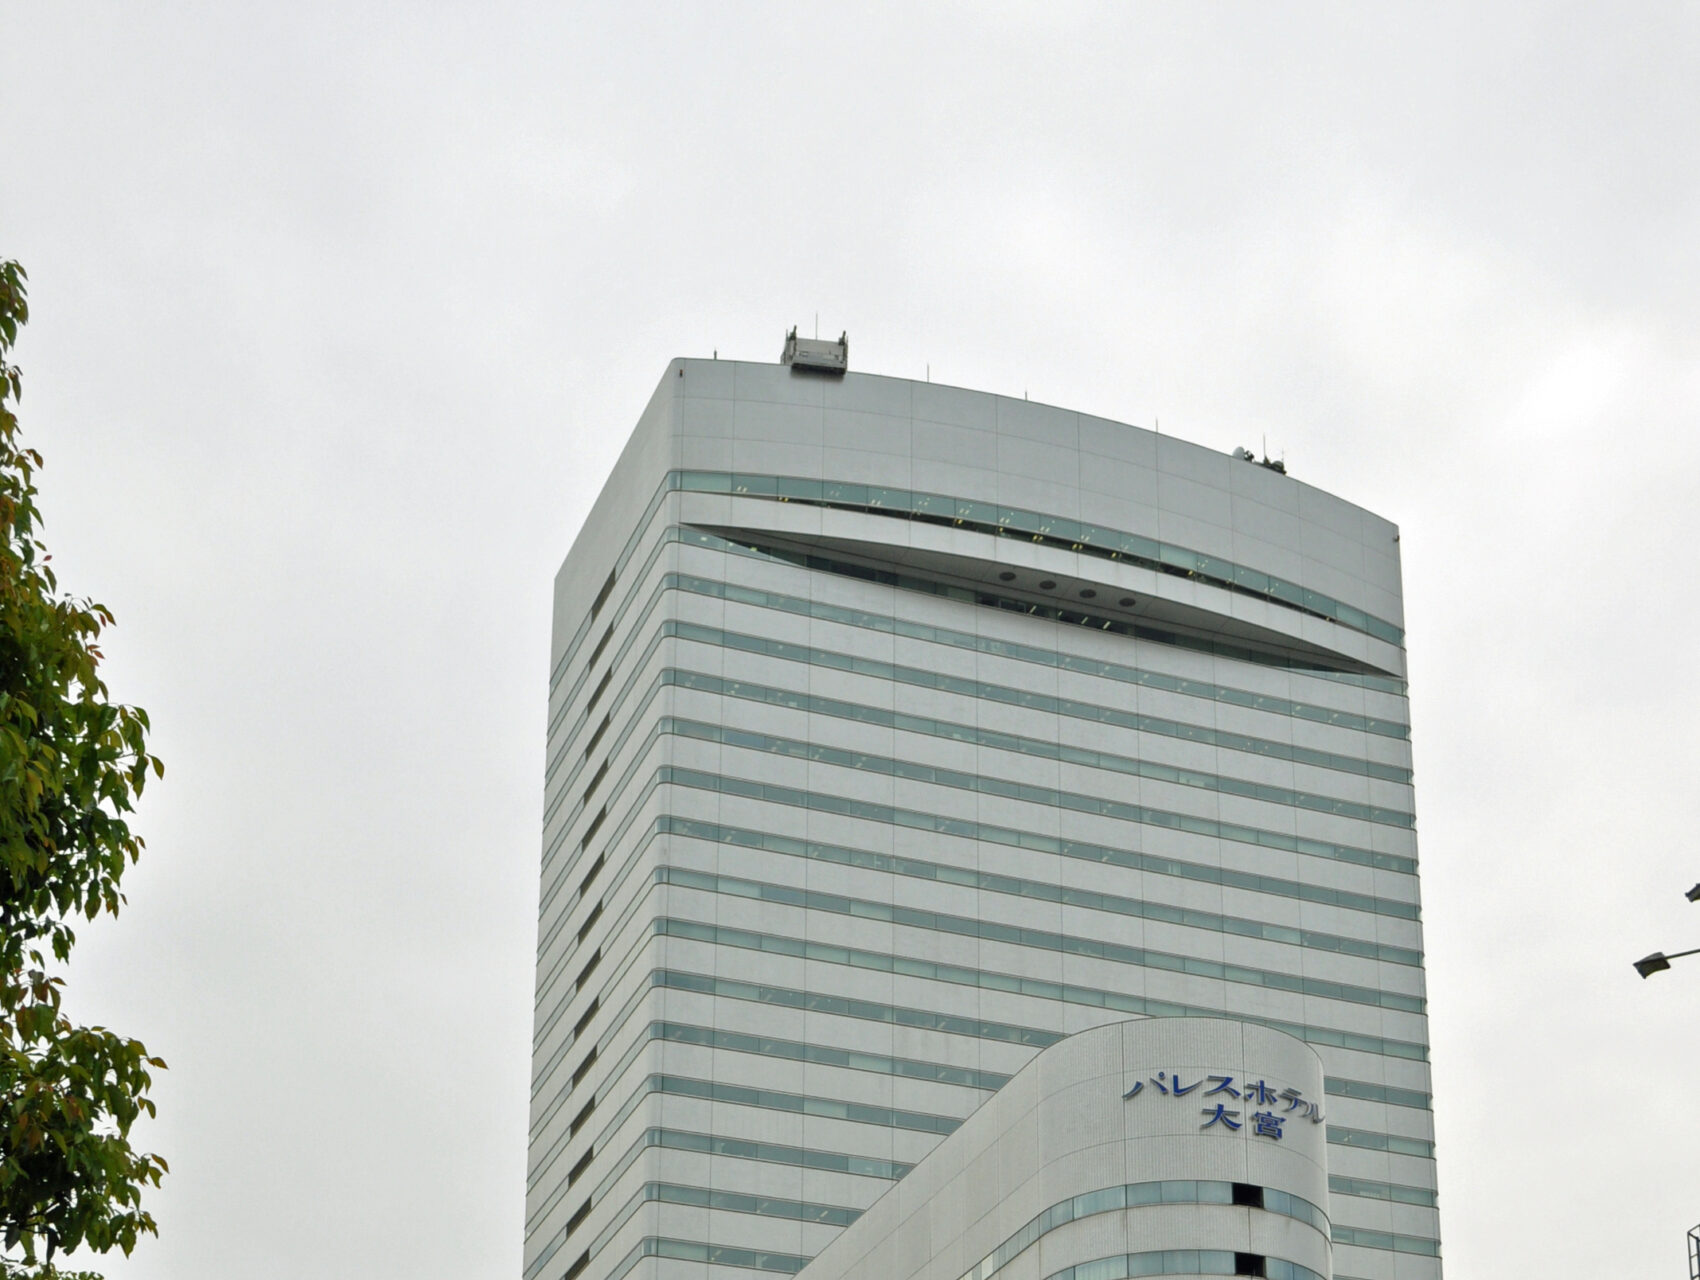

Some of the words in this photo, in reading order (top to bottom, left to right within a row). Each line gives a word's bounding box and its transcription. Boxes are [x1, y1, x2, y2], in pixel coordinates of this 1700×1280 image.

[1122, 1071, 1326, 1124] パレスホテル
[1201, 1103, 1287, 1140] 大宮
